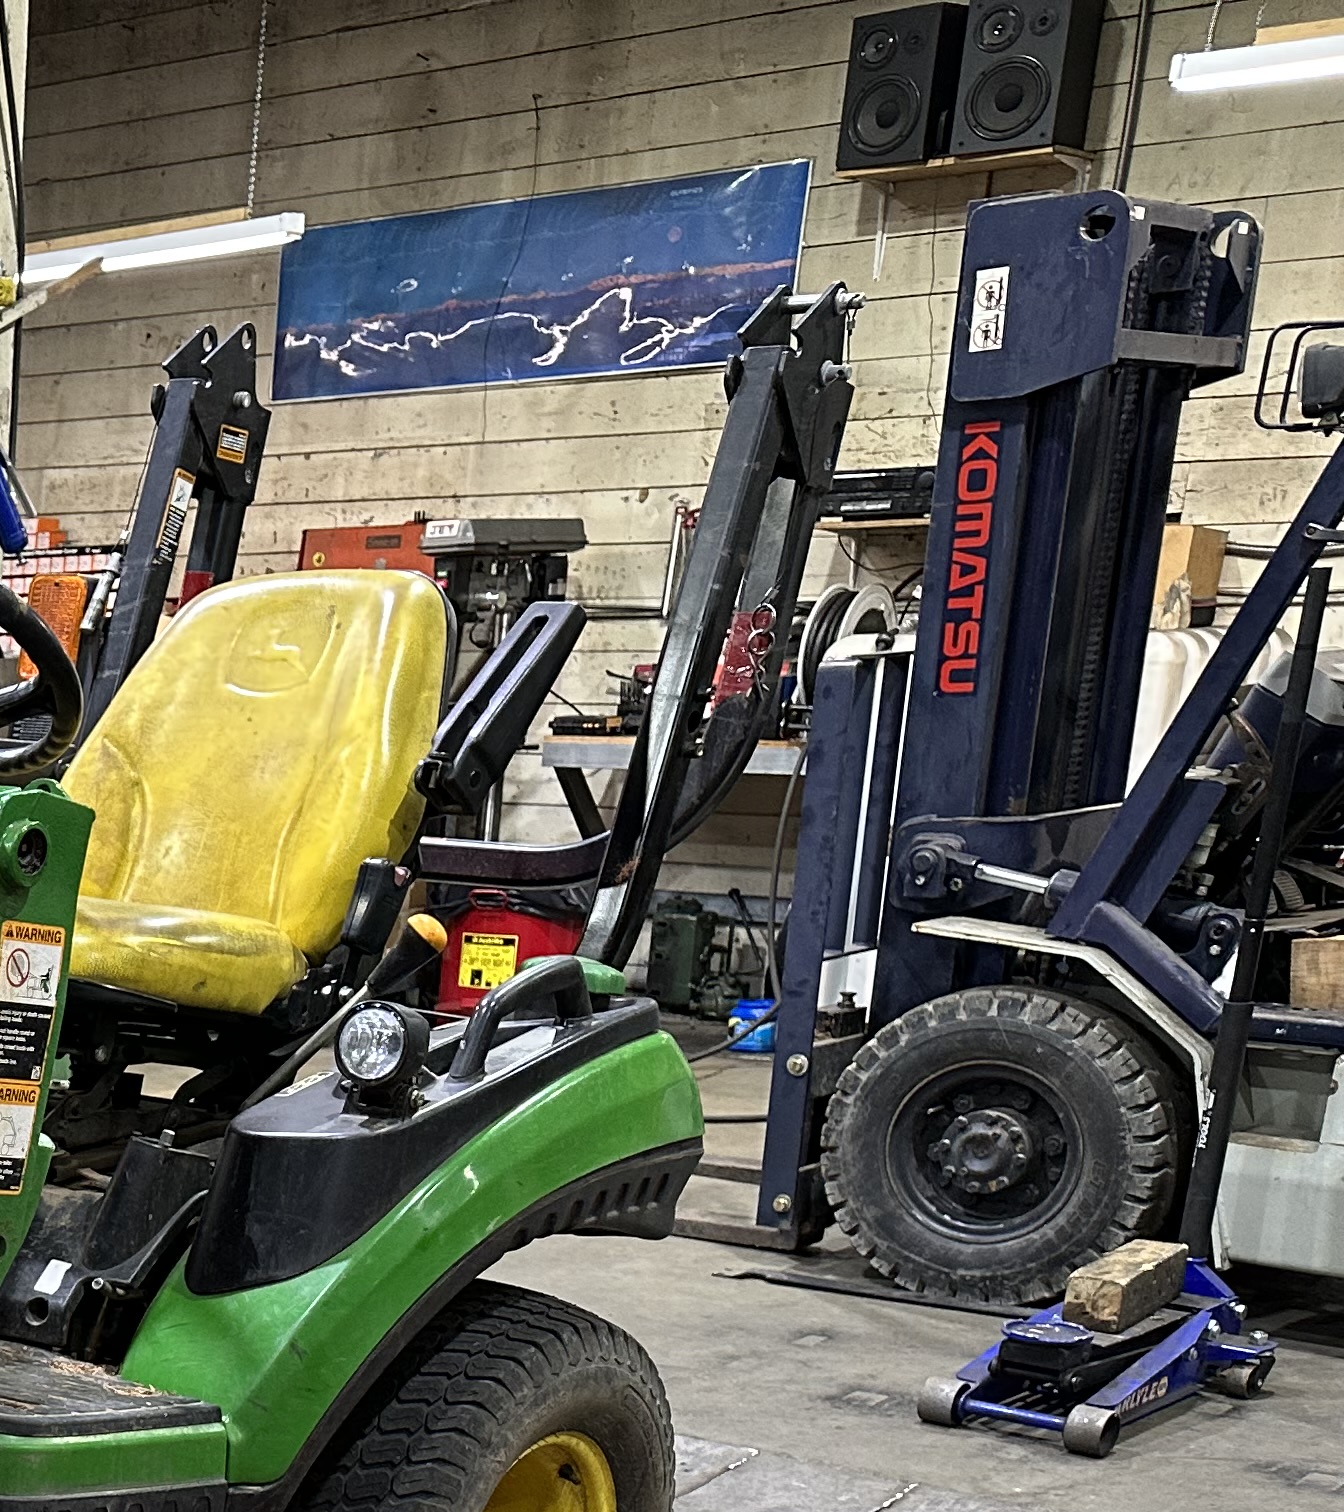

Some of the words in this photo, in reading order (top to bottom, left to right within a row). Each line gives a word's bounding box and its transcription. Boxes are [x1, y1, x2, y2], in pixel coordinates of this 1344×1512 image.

[939, 420, 1001, 694] KOMATSU
[15, 926, 62, 944] WARNING
[1198, 1116, 1211, 1149] TOOLS
